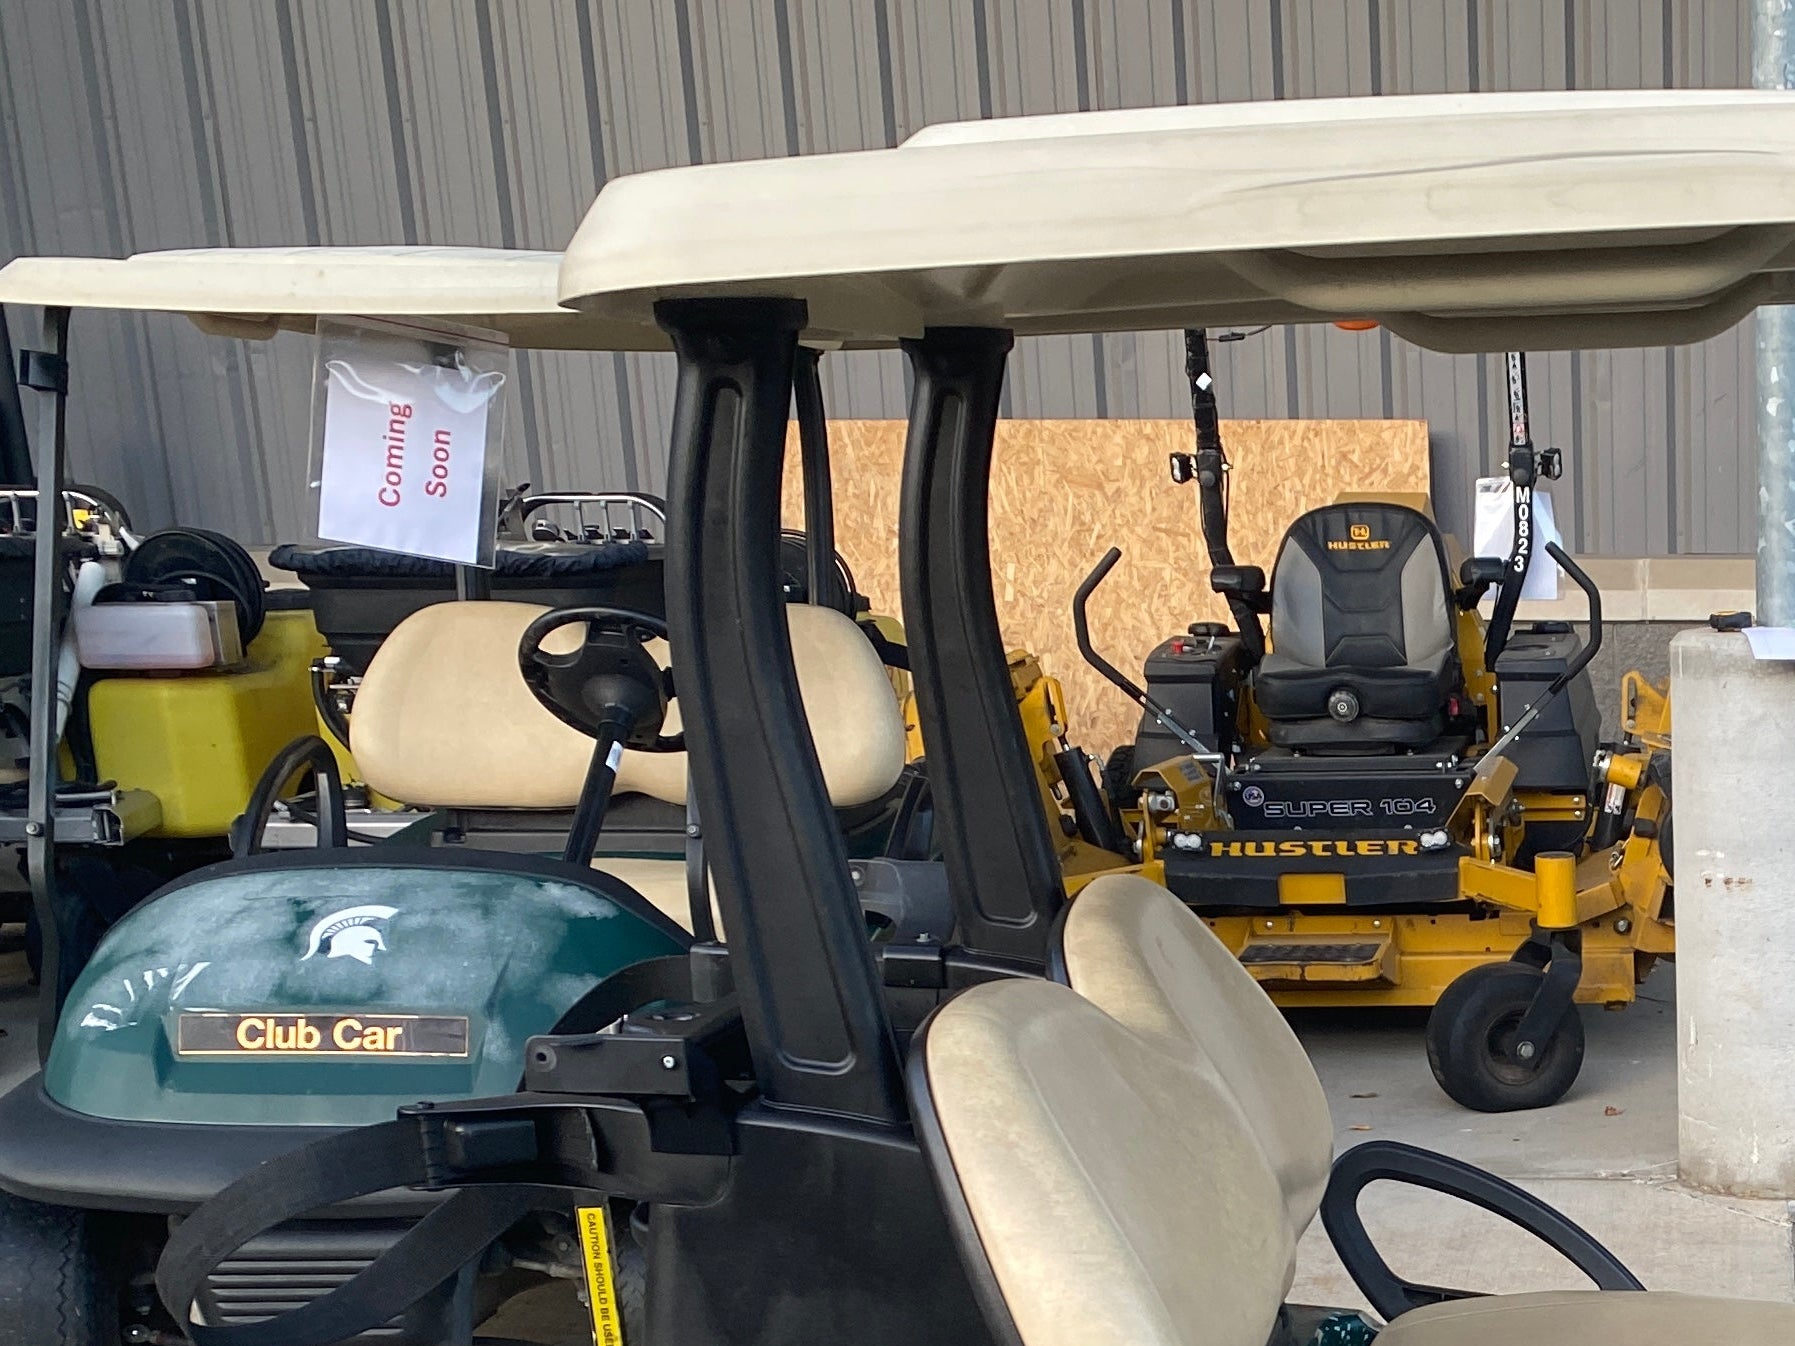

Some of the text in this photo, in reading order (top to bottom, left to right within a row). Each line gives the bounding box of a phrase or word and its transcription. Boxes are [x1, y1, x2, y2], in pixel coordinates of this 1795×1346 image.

[378, 401, 412, 507] Coming
[425, 430, 451, 498] Soon
[1327, 540, 1390, 550] HUSTLER
[1514, 487, 1530, 573] M0823
[1263, 798, 1437, 818] SUPER 104
[1209, 839, 1419, 857] HUSTLER
[236, 1017, 403, 1051] Club Car
[586, 1212, 601, 1260] CAUTION
[593, 1262, 608, 1304] SHOULD
[600, 1306, 610, 1321] BE
